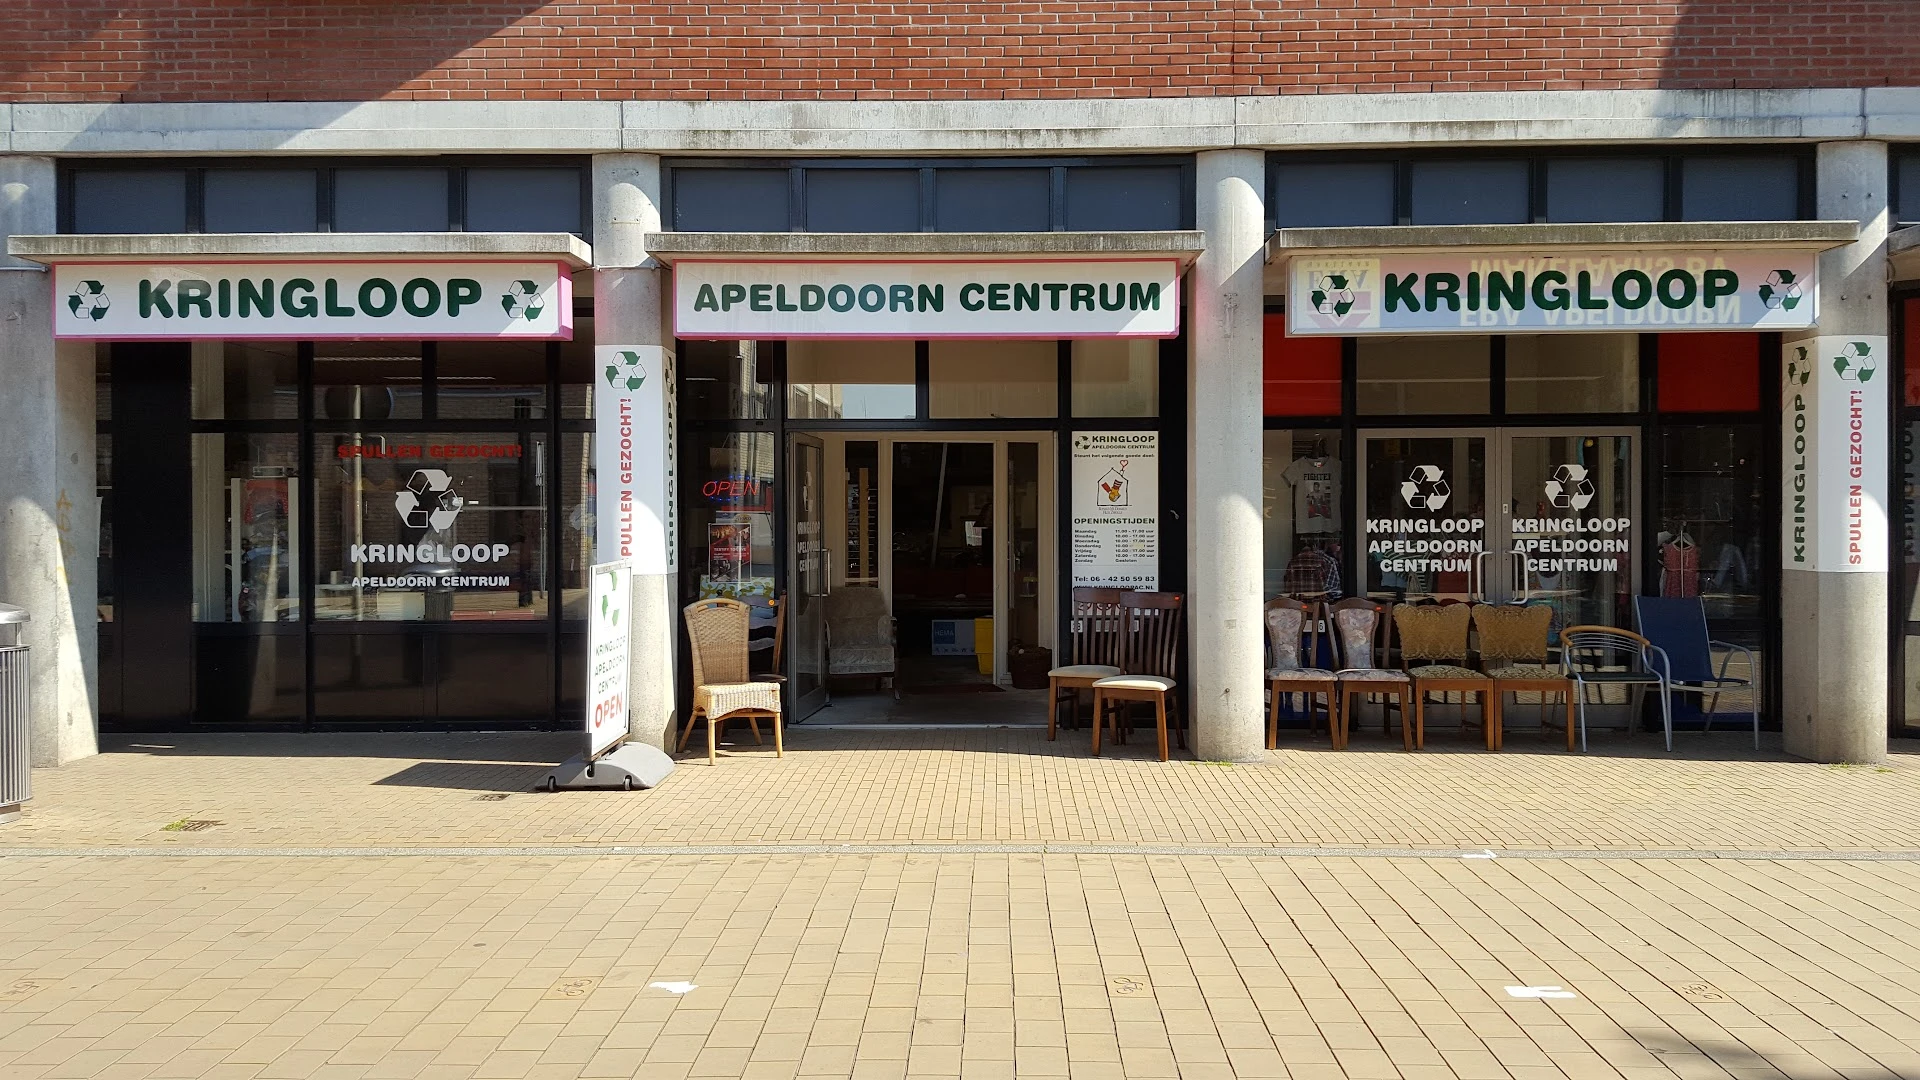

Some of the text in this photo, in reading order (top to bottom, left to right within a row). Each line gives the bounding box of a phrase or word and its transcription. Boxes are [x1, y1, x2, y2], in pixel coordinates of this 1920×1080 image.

[694, 282, 1160, 313] APELDOORN CENTRUM
[1385, 268, 1739, 312] KRINGLOOP
[139, 278, 482, 319] KRINGLOOP
[338, 444, 522, 458] SPULLEN GEZOCHT!
[620, 398, 632, 558] PULLEN GEZOCHT!
[1794, 394, 1806, 563] KRINGLOOP
[1849, 390, 1862, 565] SPULLEN GEZOCHT!
[702, 480, 760, 496] OPEN
[1366, 519, 1484, 533] KRINGLOOP
[1512, 518, 1630, 533] KRINGLOOP
[350, 543, 510, 563] KRINGLOOP
[1369, 540, 1482, 553] APELDOORN
[1514, 539, 1628, 552] APELDOORN
[1380, 559, 1472, 572] CENTRUM
[1527, 559, 1617, 572] CENTRUM
[352, 576, 510, 587] APELDOORN CENTRUM
[595, 691, 623, 728] OPEN
